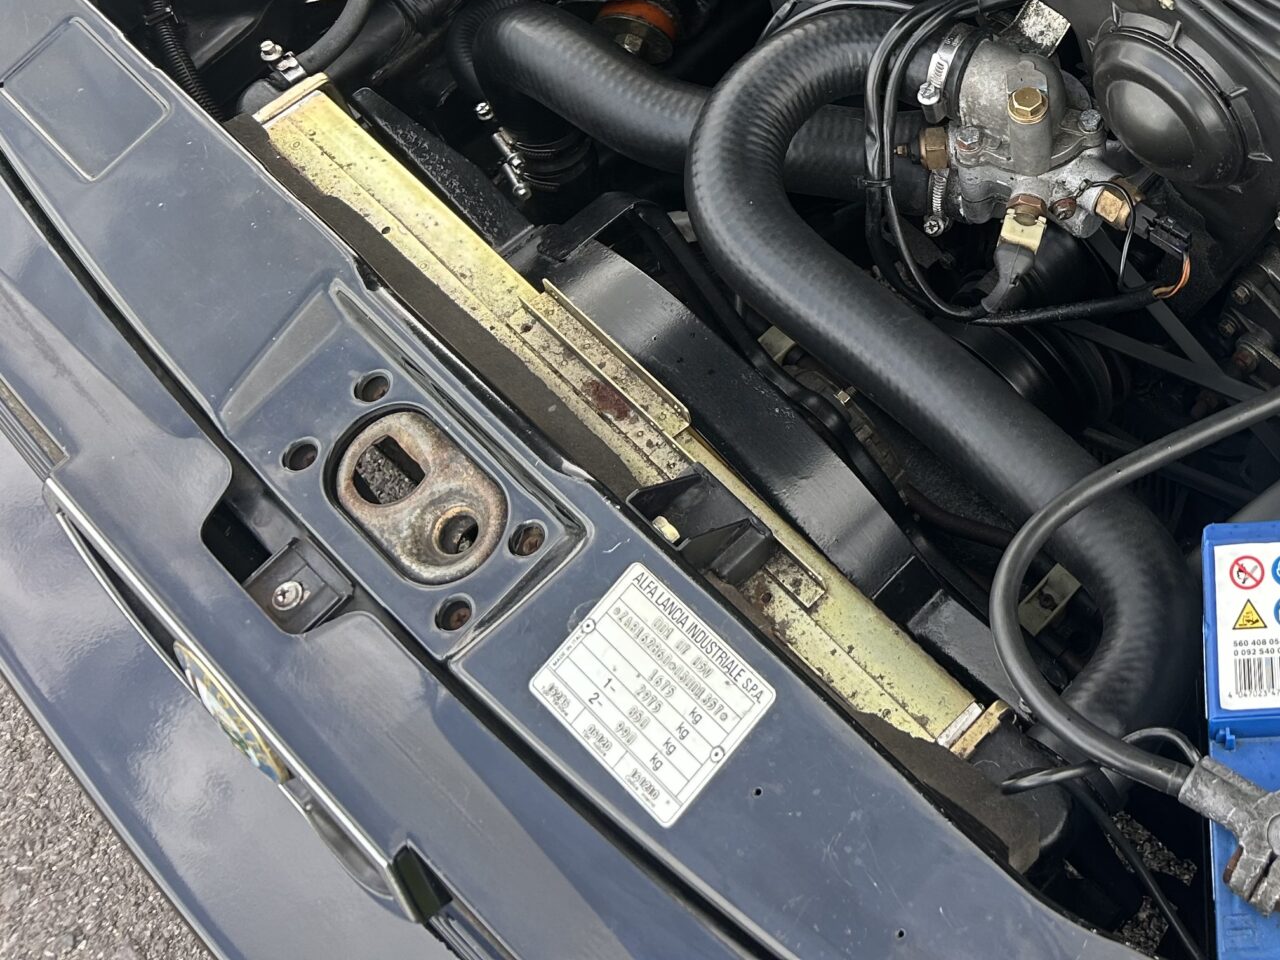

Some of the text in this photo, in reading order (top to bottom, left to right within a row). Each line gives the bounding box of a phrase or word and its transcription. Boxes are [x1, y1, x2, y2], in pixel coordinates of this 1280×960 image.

[632, 570, 768, 704] ALFA LANCIA INDUSTRIALE S.P.A.
[646, 668, 704, 725] 1675 kg
[673, 722, 692, 740] kg
[660, 737, 679, 755] kg
[646, 752, 666, 772] kg
